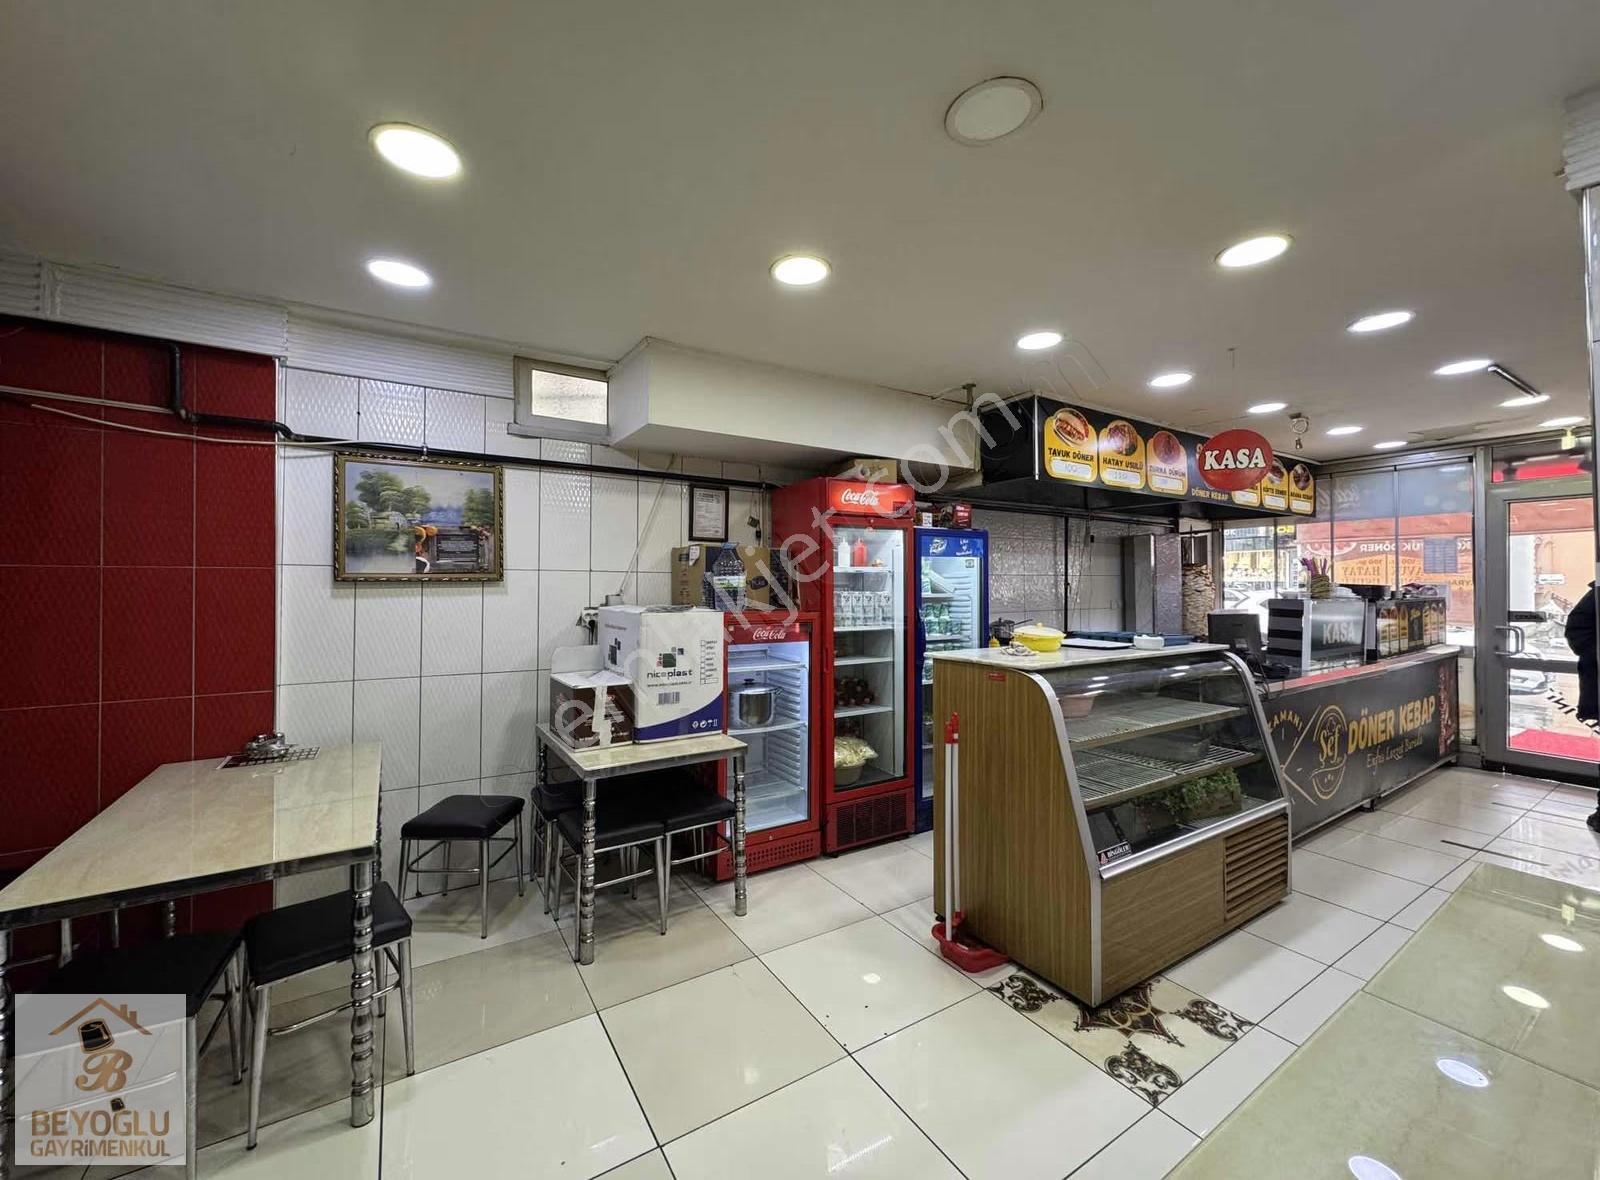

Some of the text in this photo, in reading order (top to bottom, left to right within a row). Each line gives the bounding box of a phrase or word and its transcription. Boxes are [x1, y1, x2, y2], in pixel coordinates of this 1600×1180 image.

[1048, 447, 1094, 462] TAVUK DÖNER
[1103, 457, 1123, 467] HATAY
[1204, 447, 1266, 470] KASA
[1322, 622, 1355, 645] KASA
[1348, 707, 1395, 755] DÖNER
[1399, 695, 1436, 735] KEBAP
